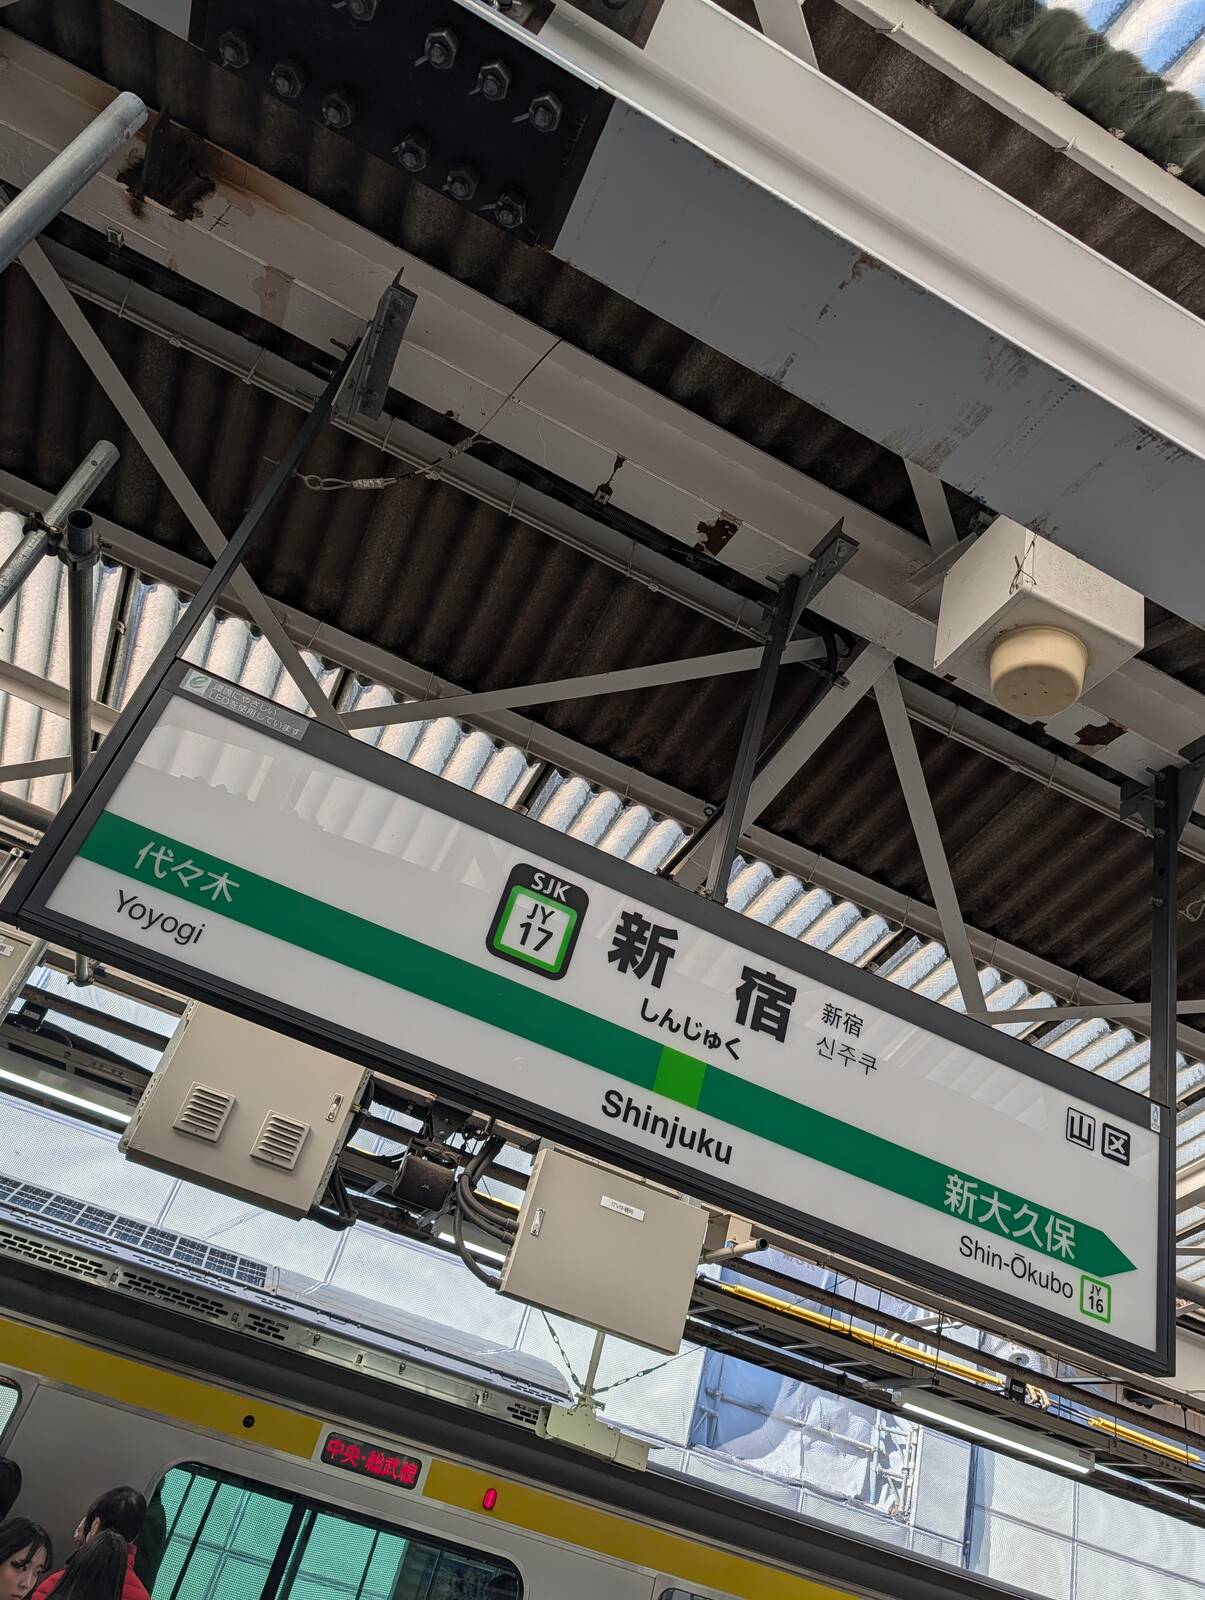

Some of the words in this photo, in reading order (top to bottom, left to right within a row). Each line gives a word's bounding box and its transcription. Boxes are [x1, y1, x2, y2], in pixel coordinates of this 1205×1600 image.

[208, 690, 301, 736] LEDを使用しています
[212, 682, 277, 716] 環境にやさしい
[134, 841, 240, 903] 代々木
[531, 872, 571, 902] SJK
[116, 889, 206, 945] Yoyogi
[526, 903, 555, 925] JY
[519, 922, 553, 952] 17
[608, 910, 797, 1043] 新宿
[640, 998, 743, 1060] しんじゅく
[821, 1002, 864, 1038] 新宿
[816, 1036, 877, 1076] 신주쿠
[601, 1089, 733, 1165] Shinjuku
[944, 1173, 1076, 1260] 新大久保
[959, 1235, 1075, 1299] Shin-Ōkubo
[1088, 1296, 1104, 1314] 16
[1090, 1283, 1103, 1297] JY
